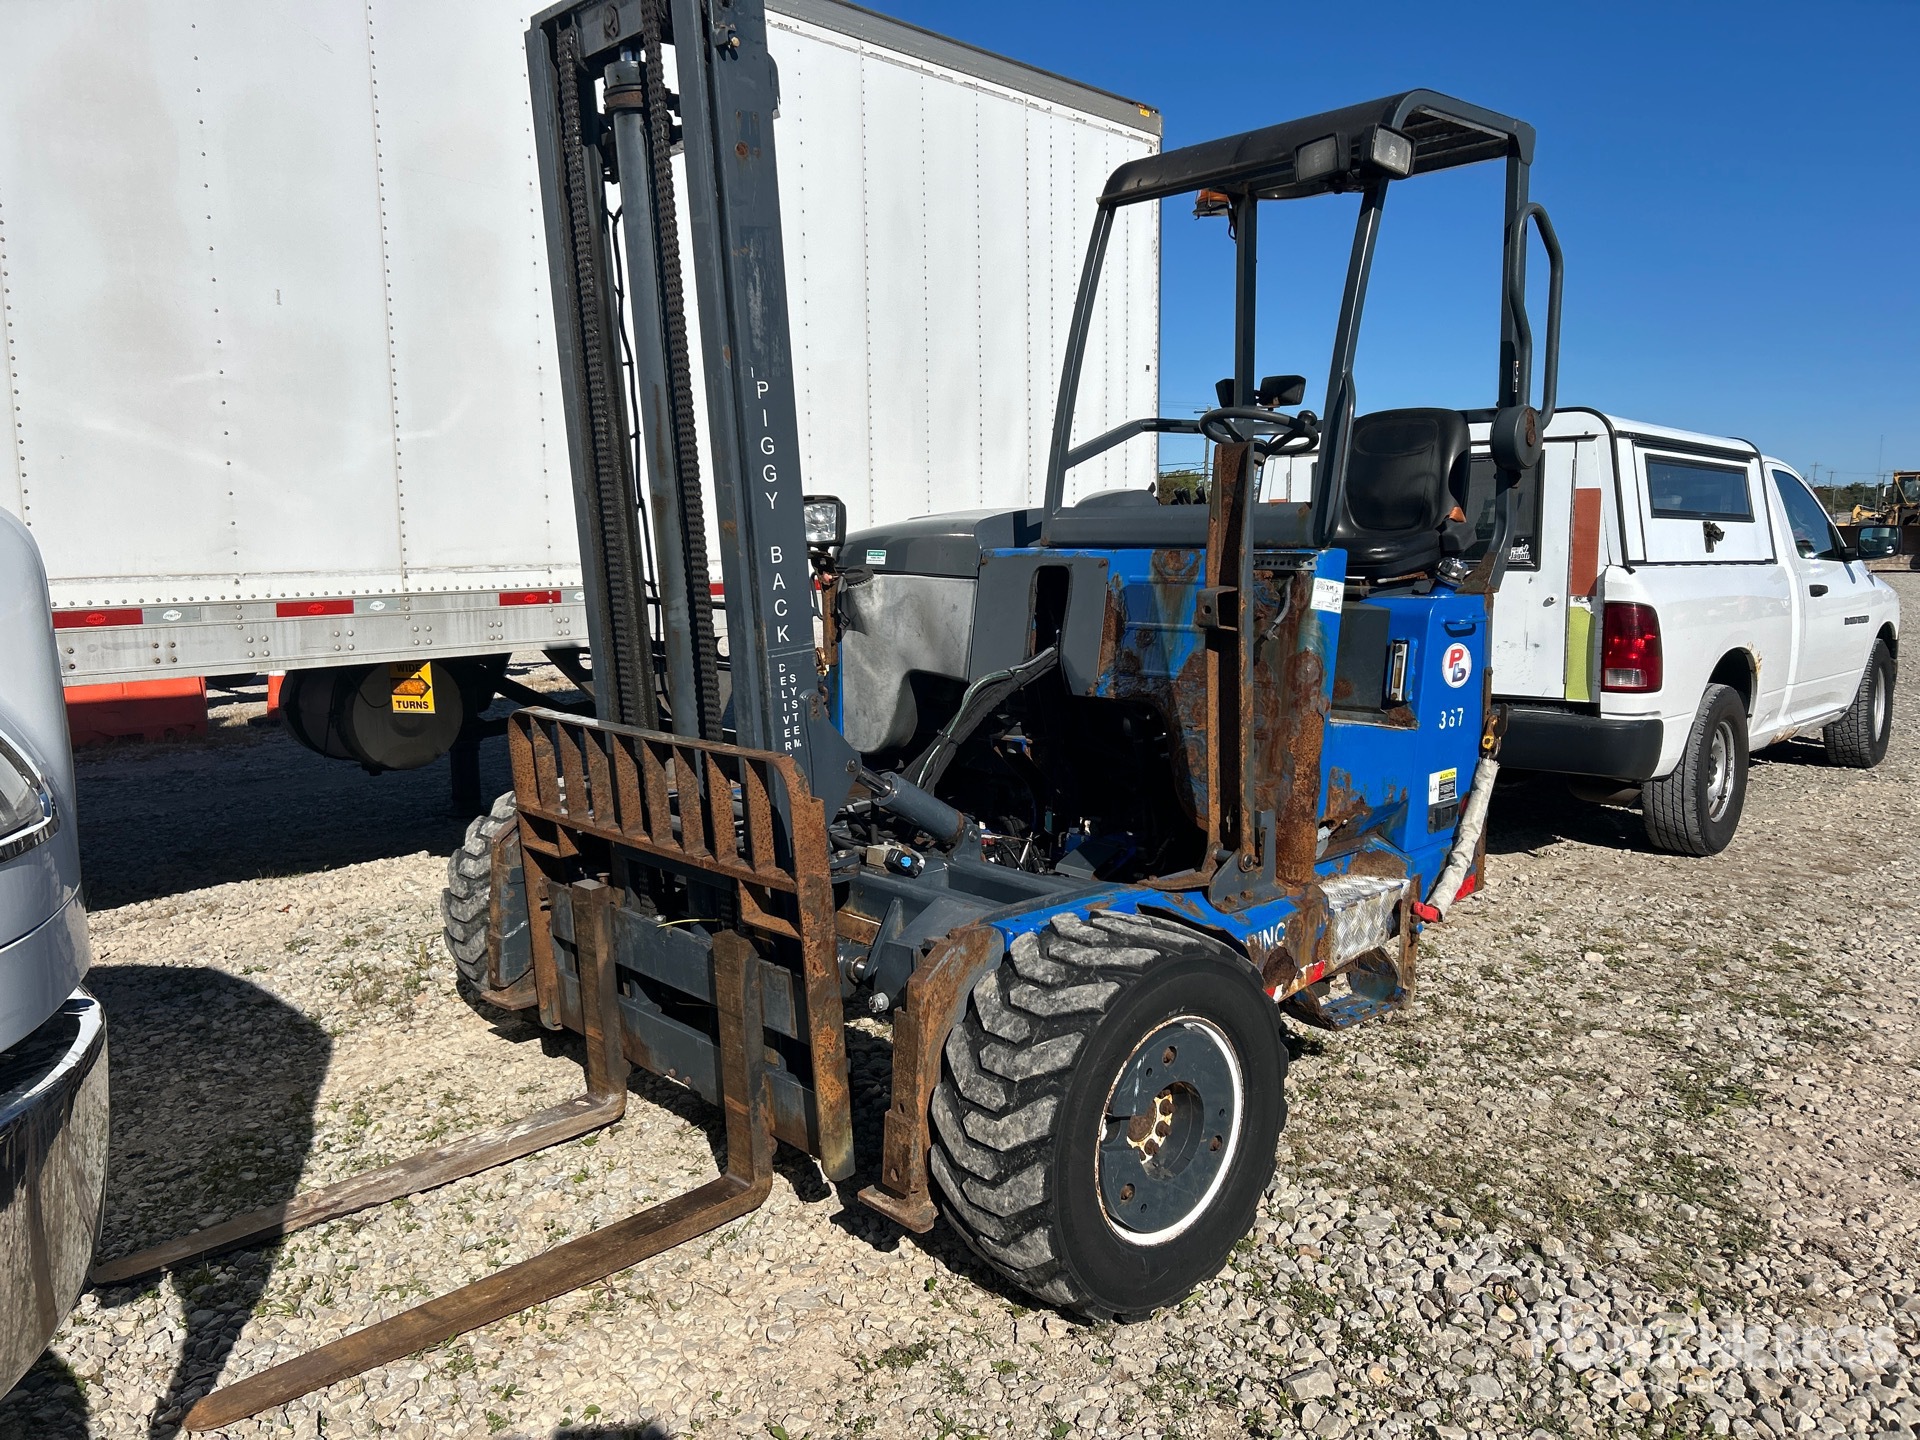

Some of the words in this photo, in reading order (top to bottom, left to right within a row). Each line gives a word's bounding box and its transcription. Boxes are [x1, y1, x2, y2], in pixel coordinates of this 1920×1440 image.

[756, 380, 778, 510] PIGGY
[770, 546, 791, 643] BACK
[396, 700, 429, 710] TURNS
[778, 663, 793, 758] DELIVER
